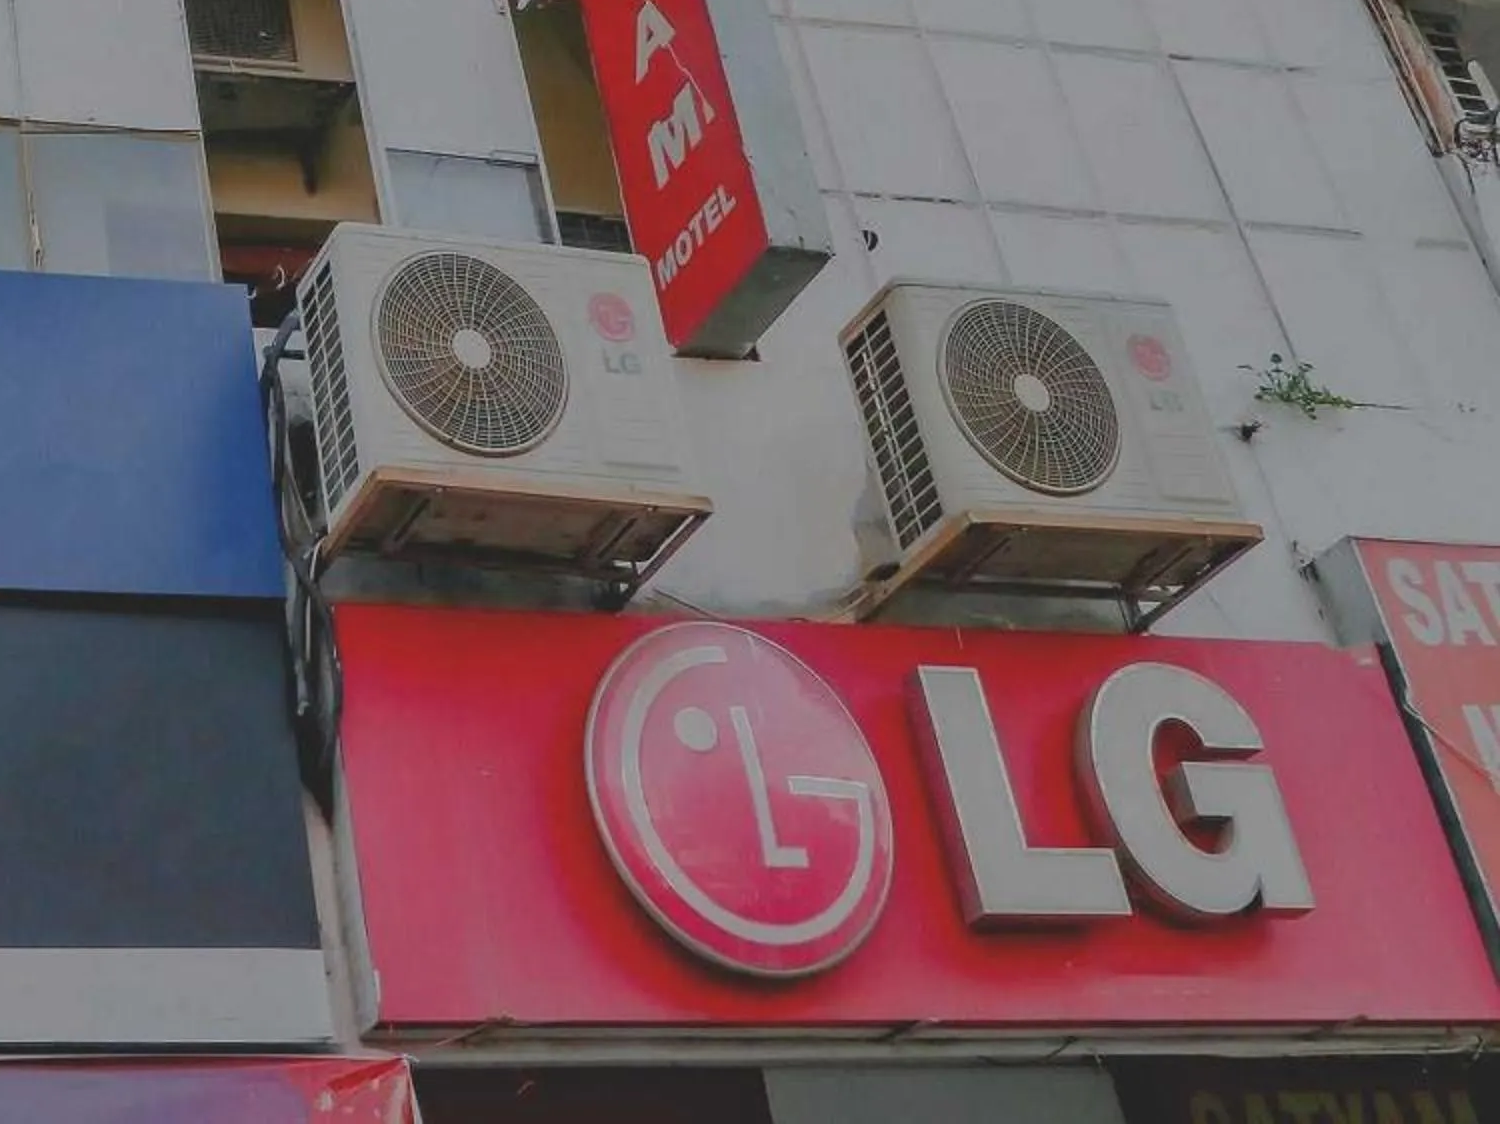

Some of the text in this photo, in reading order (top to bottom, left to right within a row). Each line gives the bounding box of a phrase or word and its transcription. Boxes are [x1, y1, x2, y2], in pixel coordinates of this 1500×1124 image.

[656, 184, 737, 291] MOTEL
[601, 348, 642, 374] LG
[911, 661, 1316, 926] LG
